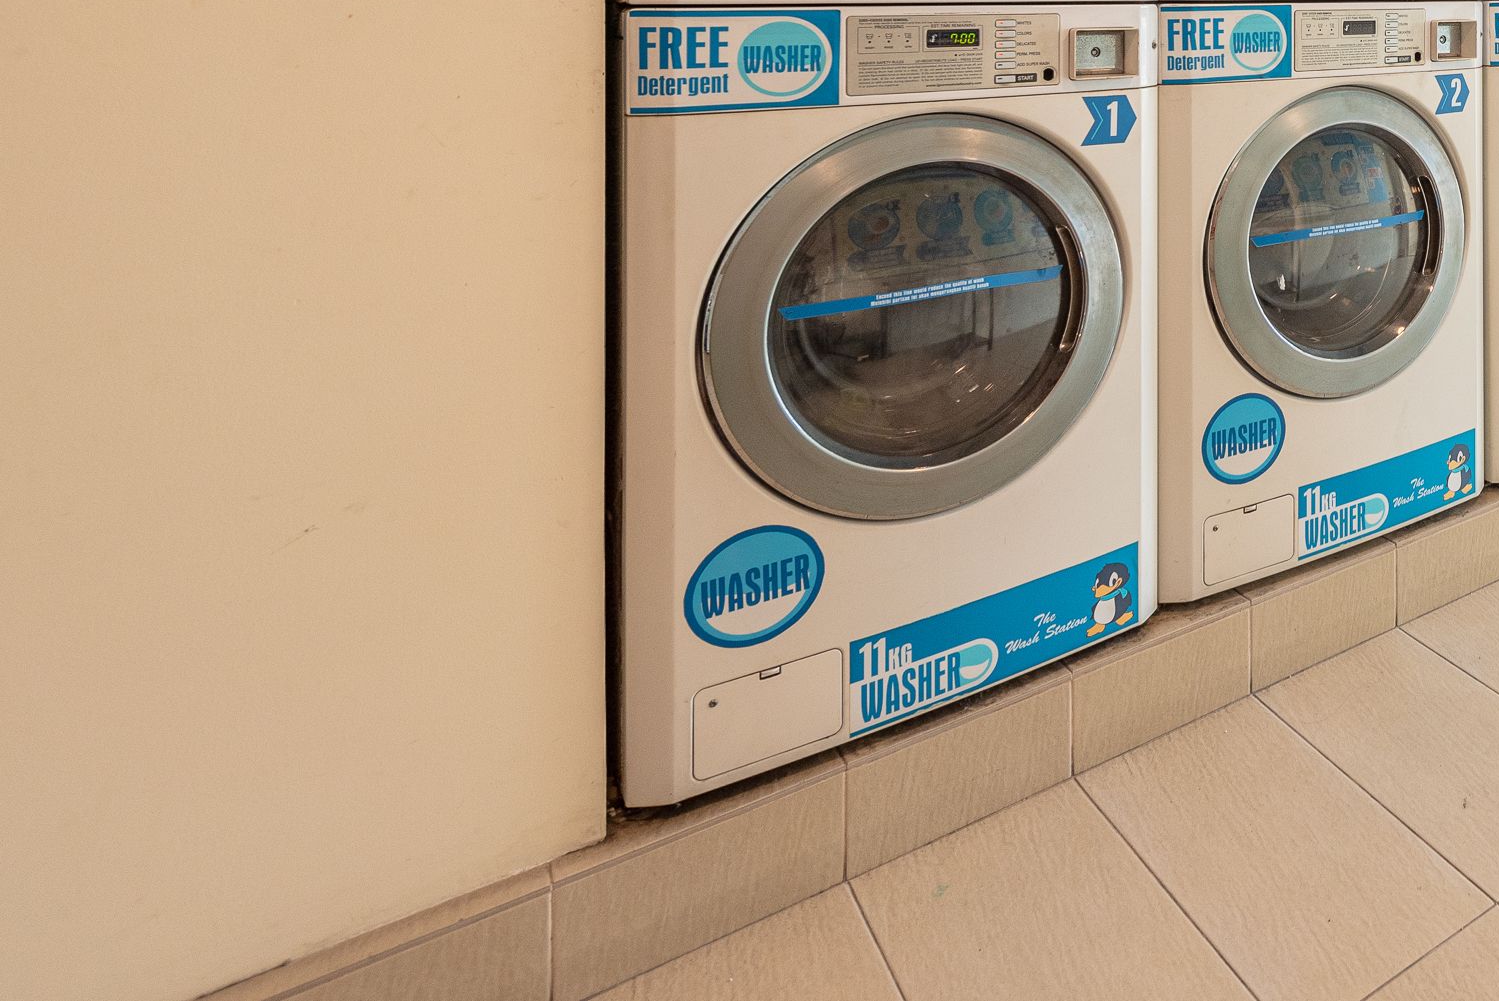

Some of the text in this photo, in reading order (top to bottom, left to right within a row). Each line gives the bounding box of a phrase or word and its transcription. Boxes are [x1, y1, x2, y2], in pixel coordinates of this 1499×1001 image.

[638, 26, 822, 74] FREE WASHER
[1167, 18, 1280, 54] FREE WASHER
[1167, 53, 1225, 71] Detergent
[637, 73, 729, 97] Detergent
[1450, 77, 1462, 107] 2
[1106, 100, 1118, 137] 1
[1211, 417, 1278, 461] WASHER
[1303, 485, 1337, 517] 11KG
[1392, 483, 1445, 508] Wash Station
[1410, 477, 1425, 489] The
[1304, 501, 1366, 551] WASHER
[700, 553, 810, 620] WASHER
[1004, 615, 1088, 655] Wash Station
[1033, 611, 1056, 628] The
[858, 637, 913, 680] 11KG
[860, 651, 961, 723] WASHER
